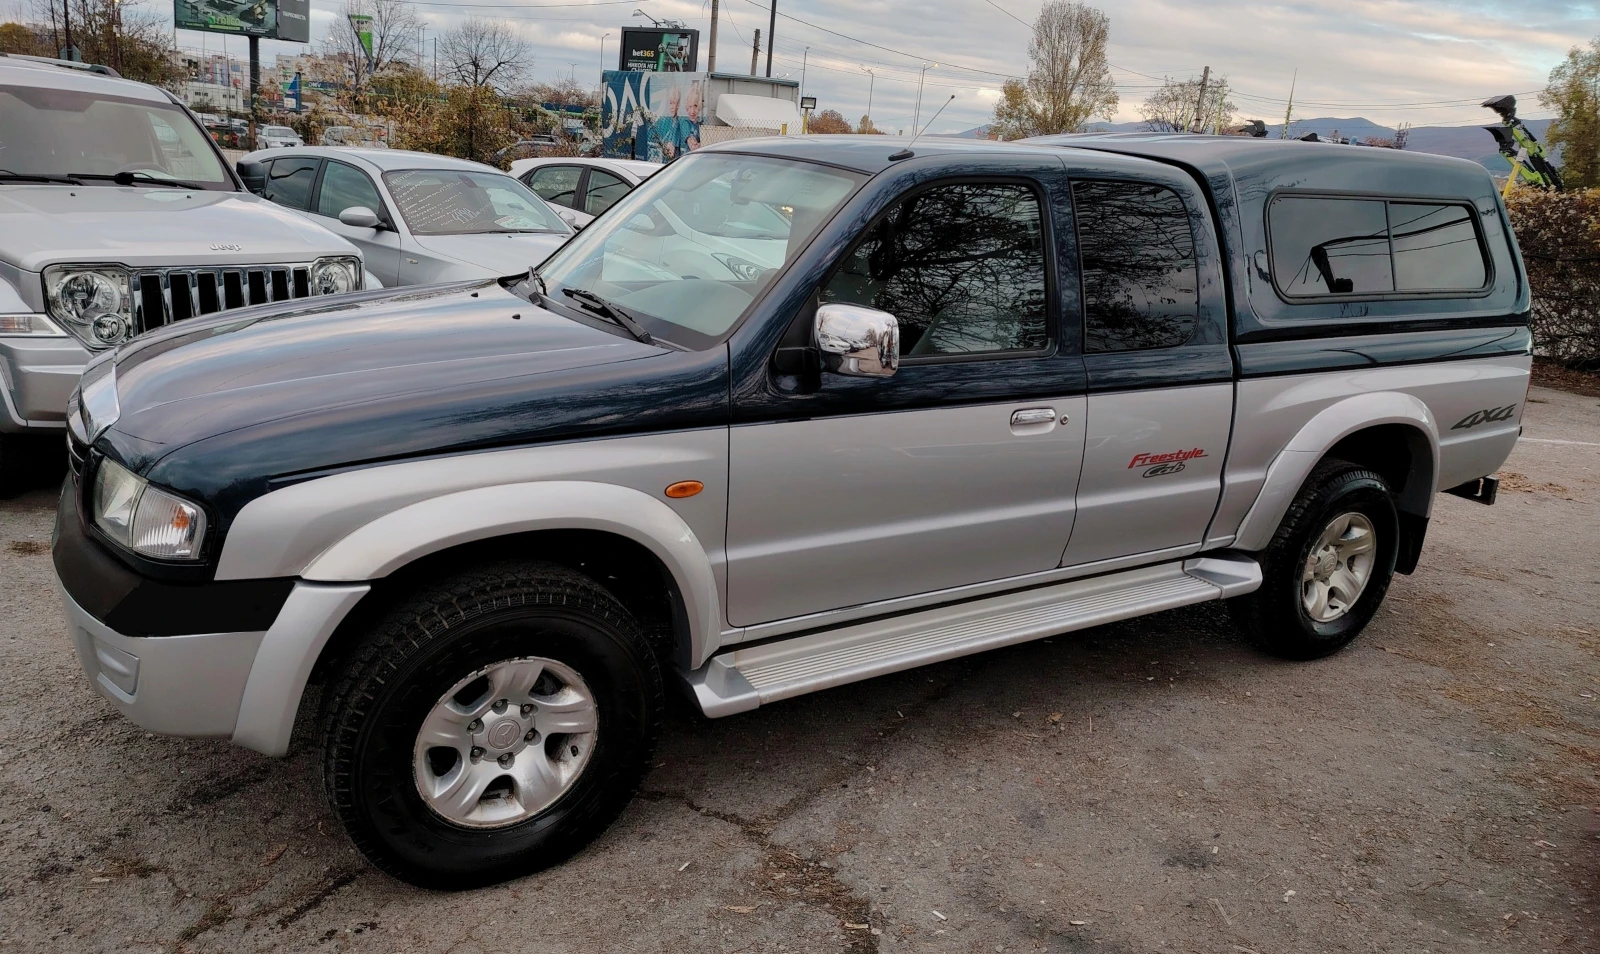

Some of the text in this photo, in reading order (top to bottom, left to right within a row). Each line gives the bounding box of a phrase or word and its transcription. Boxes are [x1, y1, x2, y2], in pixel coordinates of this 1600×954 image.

[632, 49, 655, 57] bet365
[209, 243, 242, 251] Jeep
[1127, 447, 1208, 469] Freestyle
[1142, 461, 1186, 478] Cab
